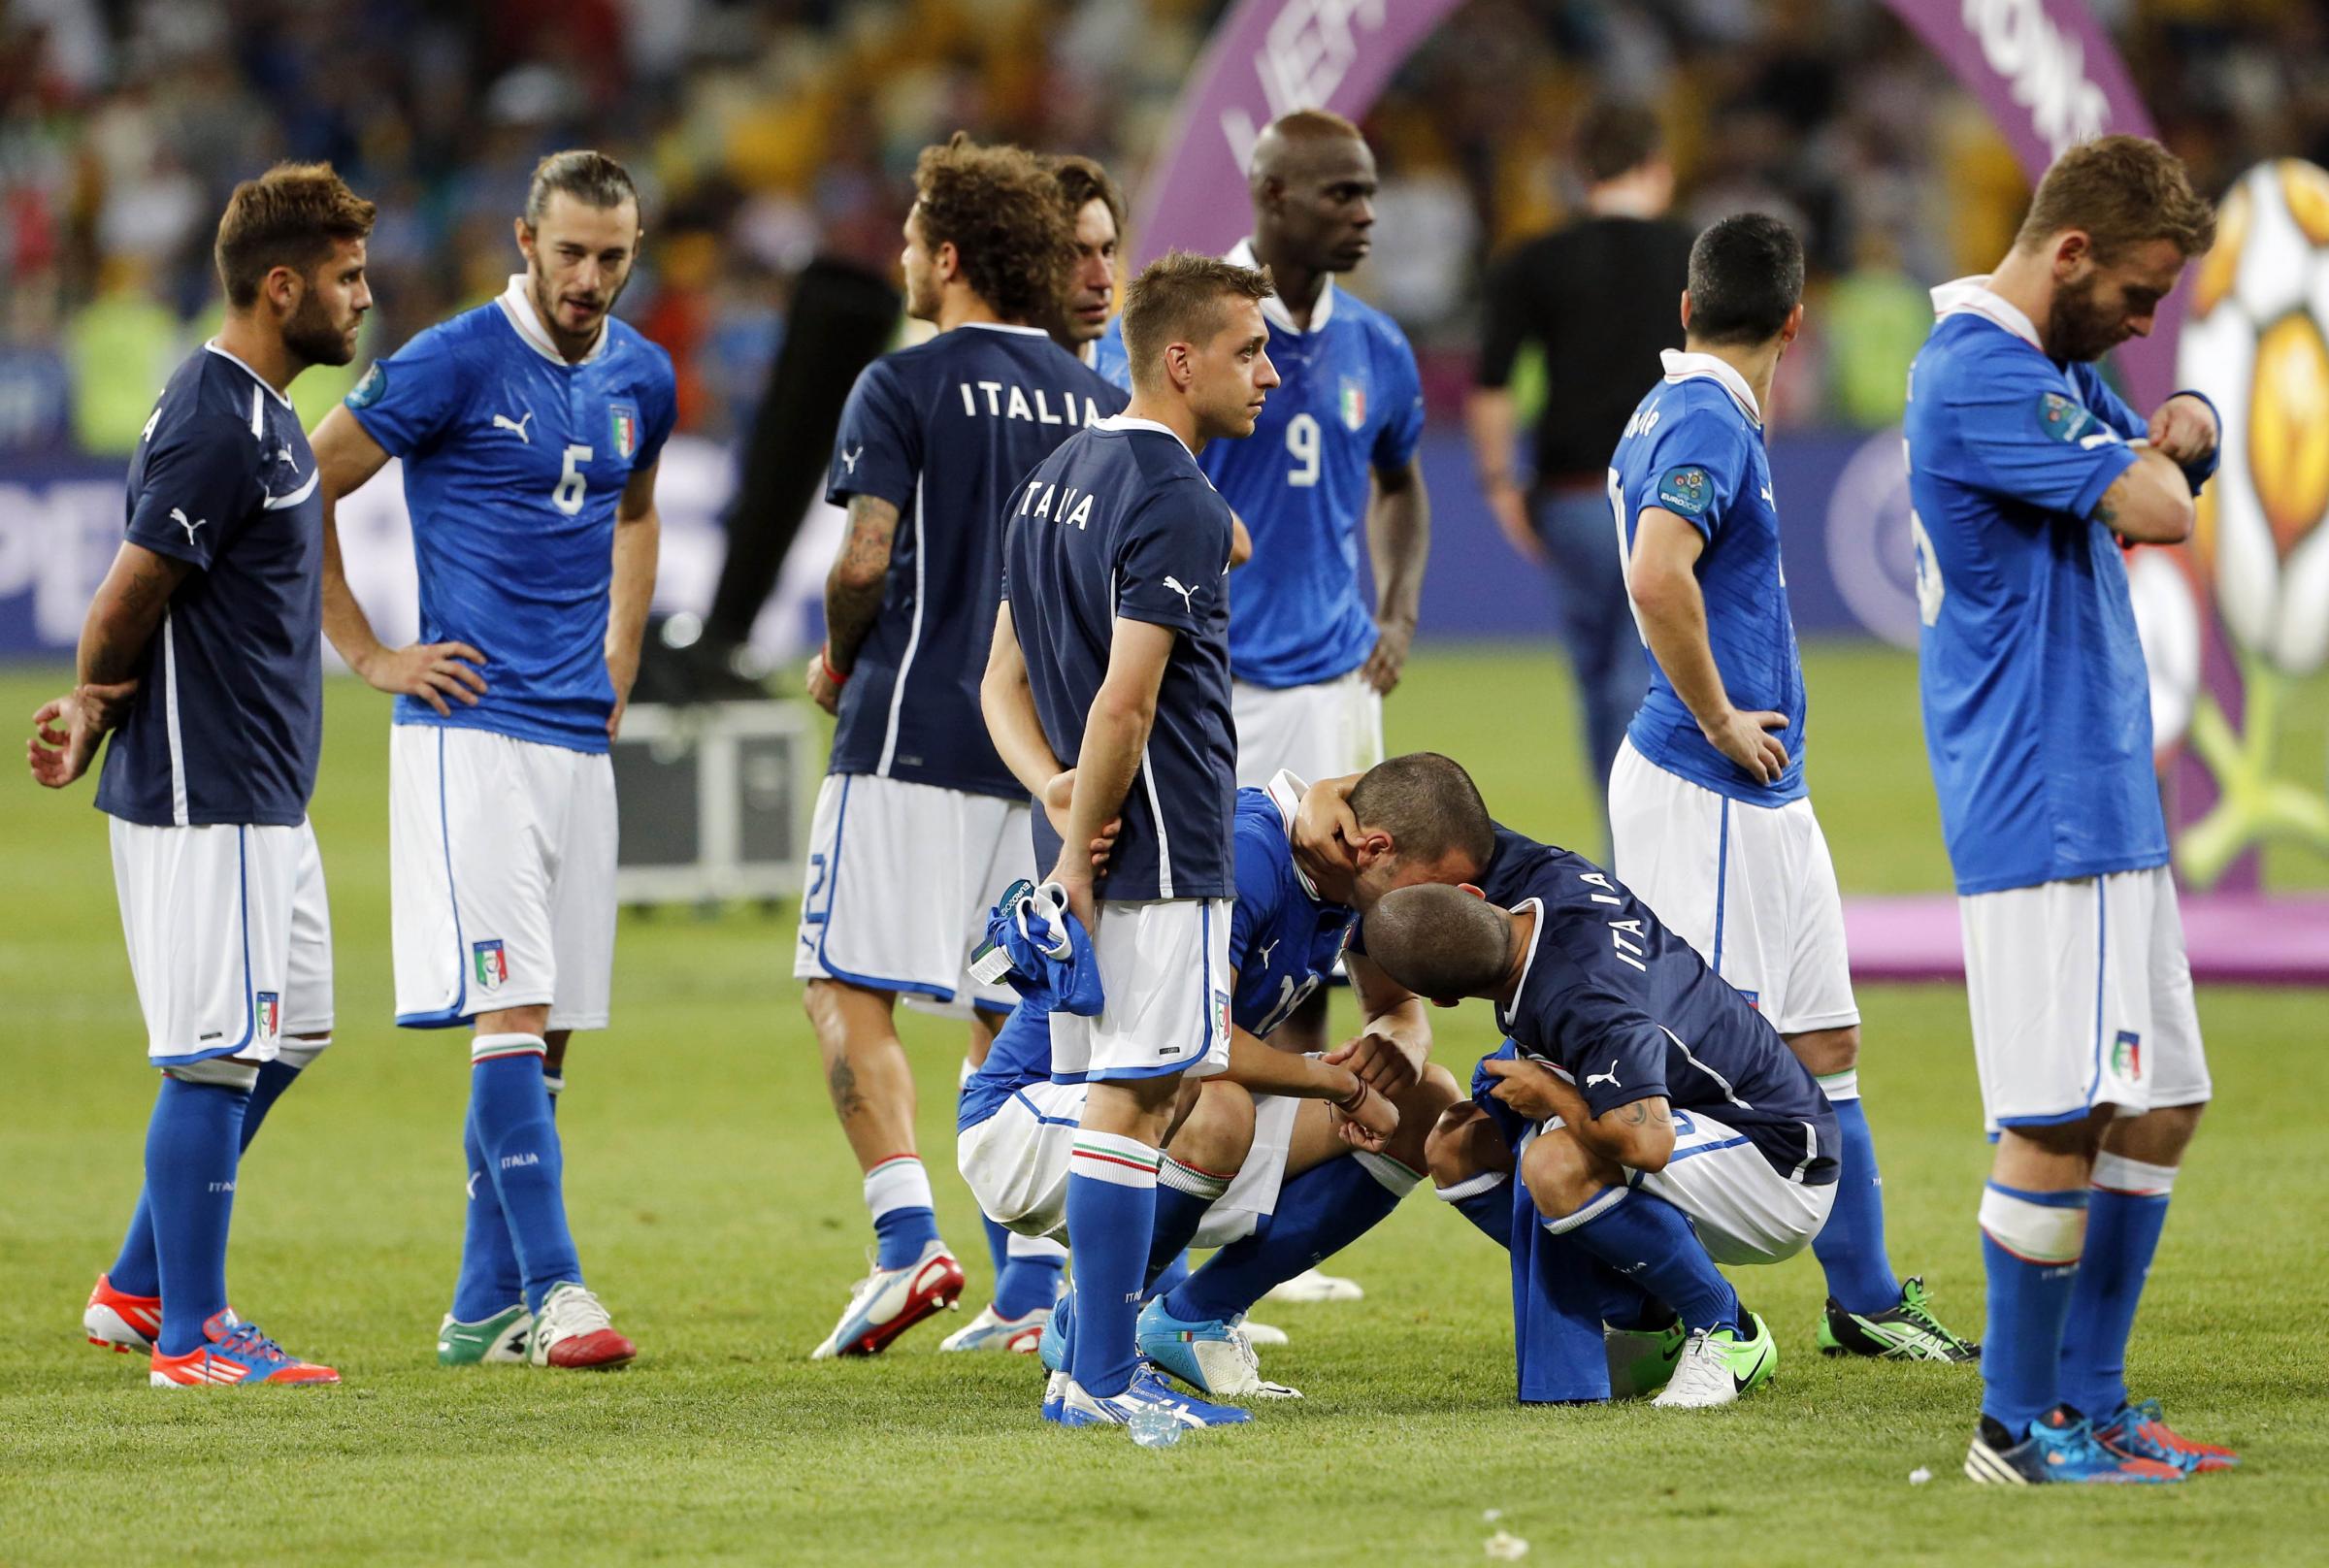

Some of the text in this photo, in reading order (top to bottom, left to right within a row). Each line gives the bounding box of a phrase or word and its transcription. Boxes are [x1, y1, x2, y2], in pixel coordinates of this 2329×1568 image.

[960, 380, 1100, 429] ITALIA
[551, 443, 593, 515] 6
[1286, 413, 1321, 487] 9
[1014, 481, 1094, 531] TALIA
[1000, 881, 1032, 917] EURO2012
[1579, 872, 1647, 972] ITAIA
